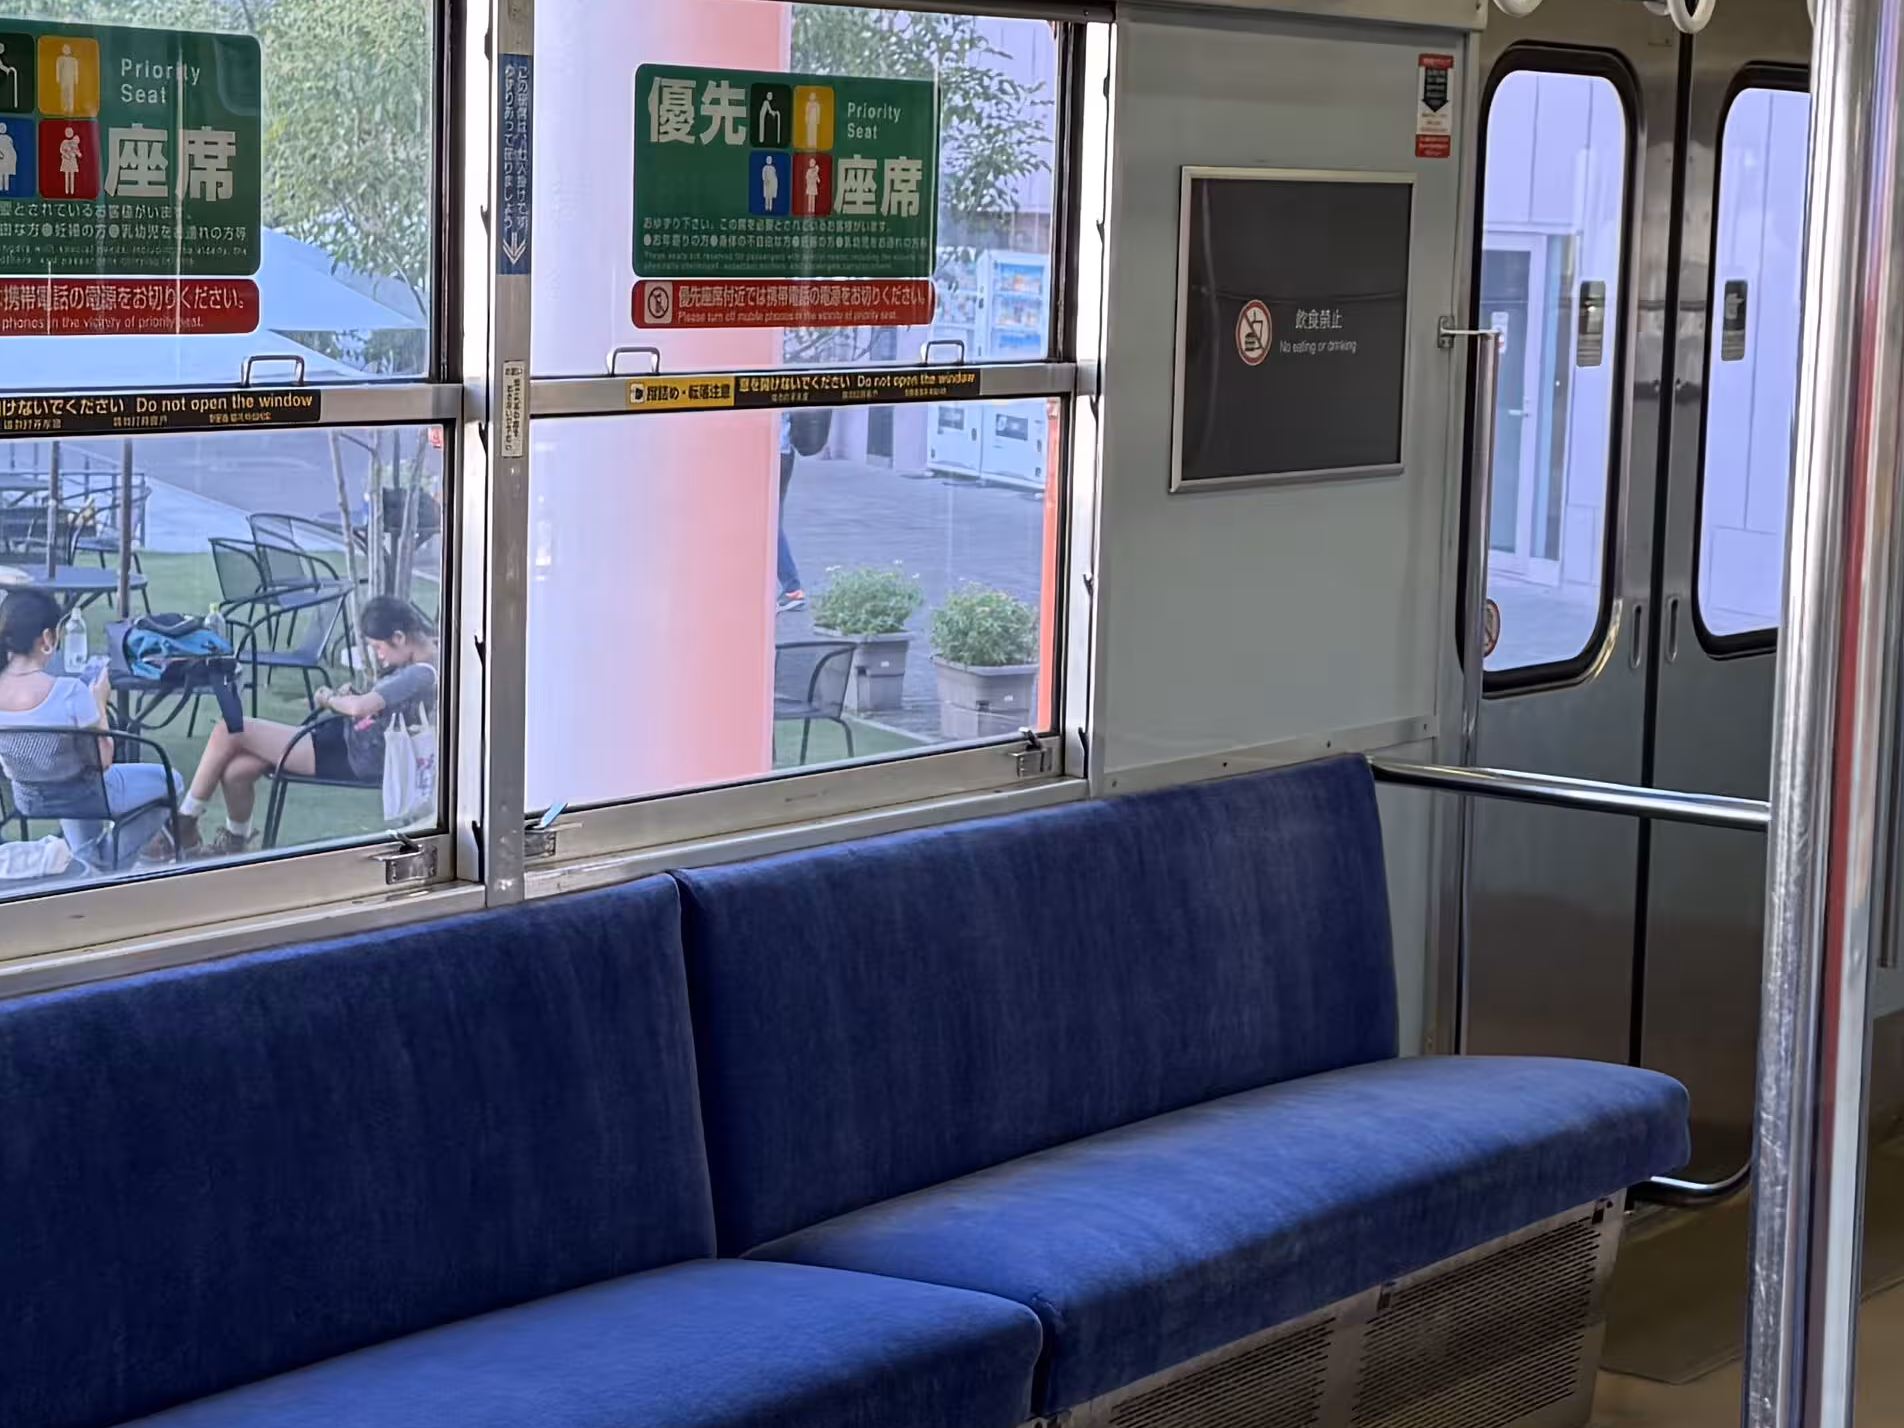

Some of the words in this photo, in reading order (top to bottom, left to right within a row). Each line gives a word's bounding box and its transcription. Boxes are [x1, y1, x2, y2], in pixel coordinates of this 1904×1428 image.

[121, 84, 166, 104] Seat
[648, 77, 747, 145] 優先
[848, 102, 901, 123] Priority
[848, 123, 877, 140] Seat
[104, 123, 236, 201] 座席
[834, 154, 922, 216] 座席
[858, 376, 871, 388] Do
[136, 398, 158, 412] Do
[162, 397, 186, 411] not
[191, 398, 227, 414] open
[232, 394, 254, 409] the
[259, 394, 312, 409] window
